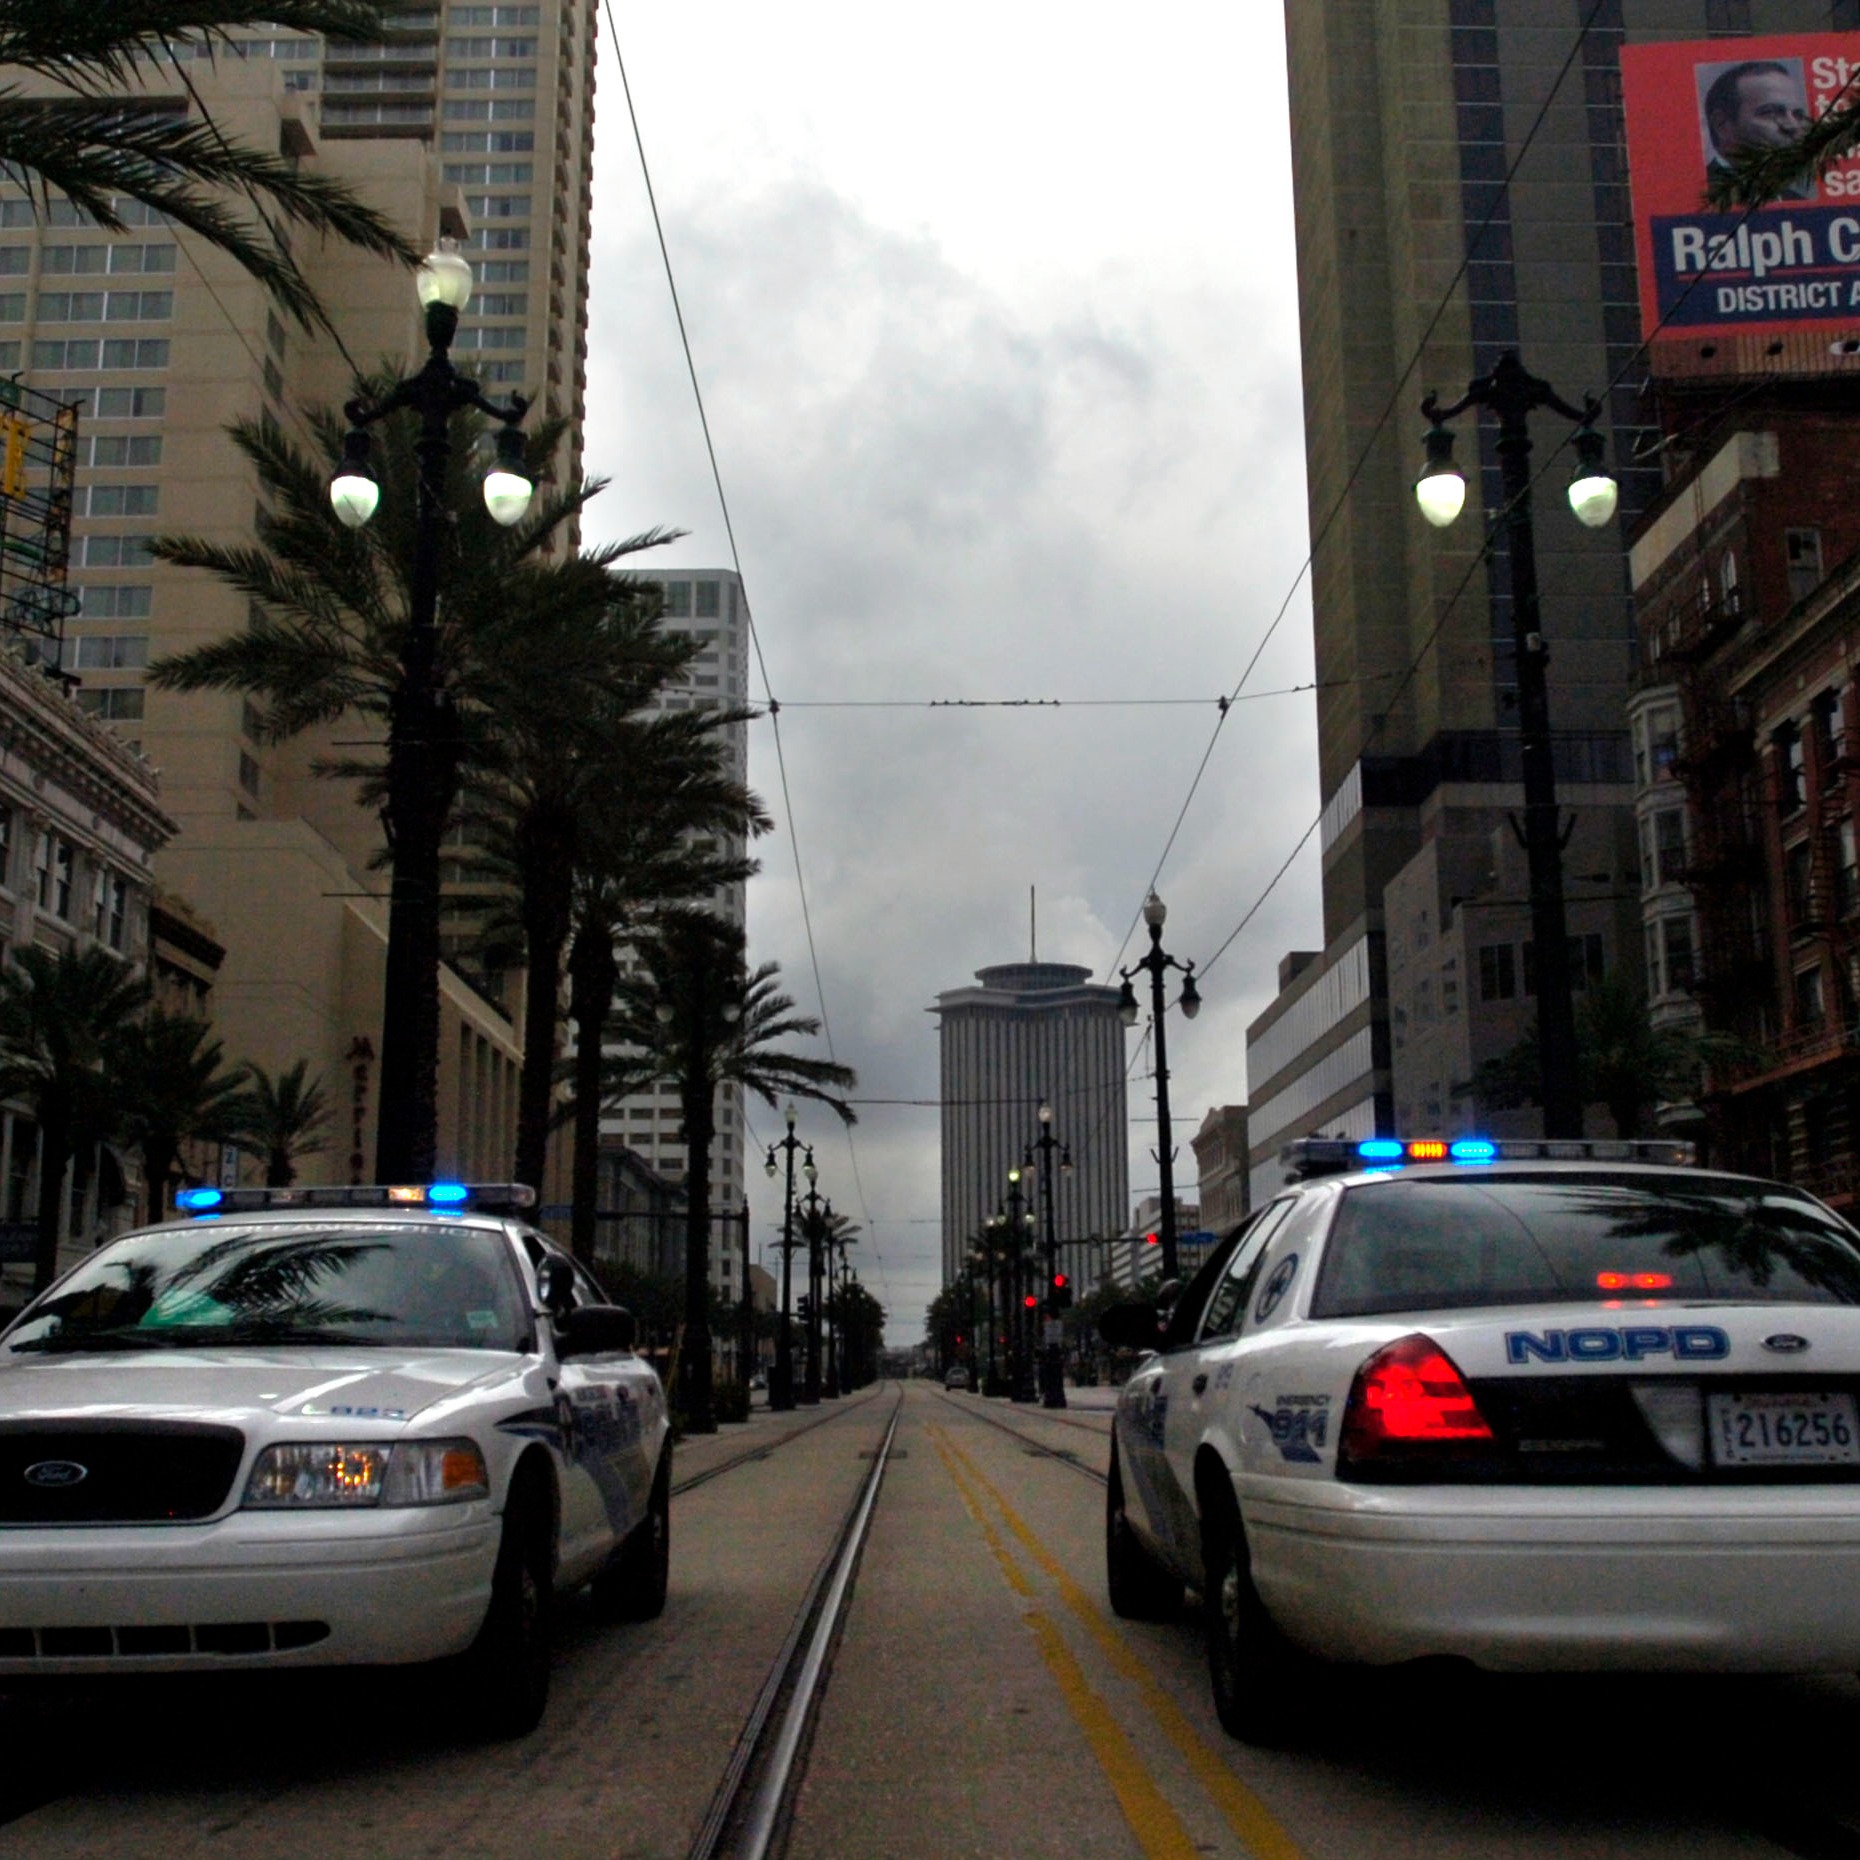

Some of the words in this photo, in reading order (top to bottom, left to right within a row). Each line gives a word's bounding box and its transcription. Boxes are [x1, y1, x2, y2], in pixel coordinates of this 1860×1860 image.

[1672, 221, 1814, 278] Ralph
[1716, 282, 1842, 314] DISTRICT
[1505, 1325, 1731, 1364] NOPD
[1273, 1409, 1329, 1447] 911
[1736, 1412, 1851, 1447] 216256
